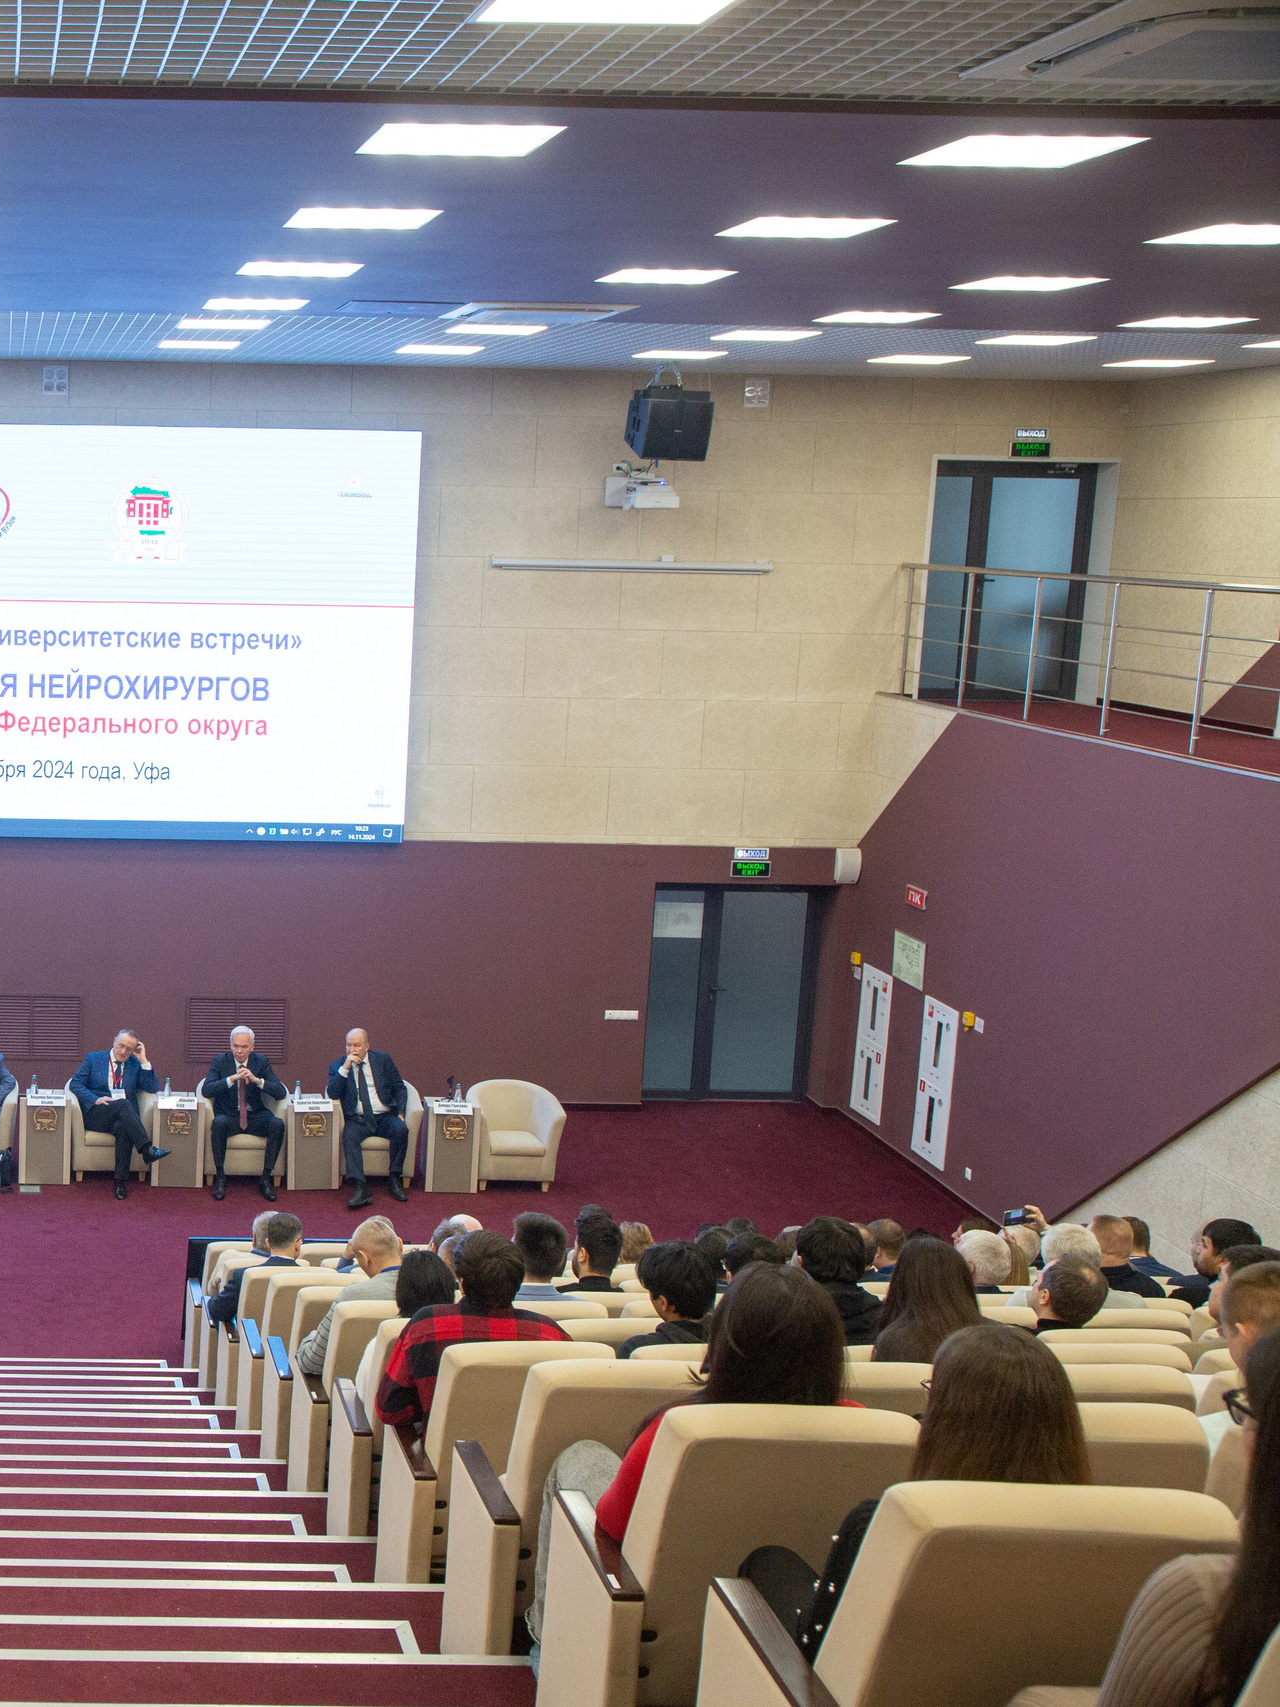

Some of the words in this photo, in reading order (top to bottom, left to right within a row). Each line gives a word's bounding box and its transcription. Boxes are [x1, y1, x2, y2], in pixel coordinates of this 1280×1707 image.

[190, 632, 302, 655] встречи»
[28, 668, 270, 701] НЕЙРОХИРУРГОВ
[187, 718, 267, 741] округа
[32, 760, 74, 778] 2024
[81, 764, 125, 783] года,
[133, 762, 170, 784] Уфа
[908, 890, 921, 905] ПК
